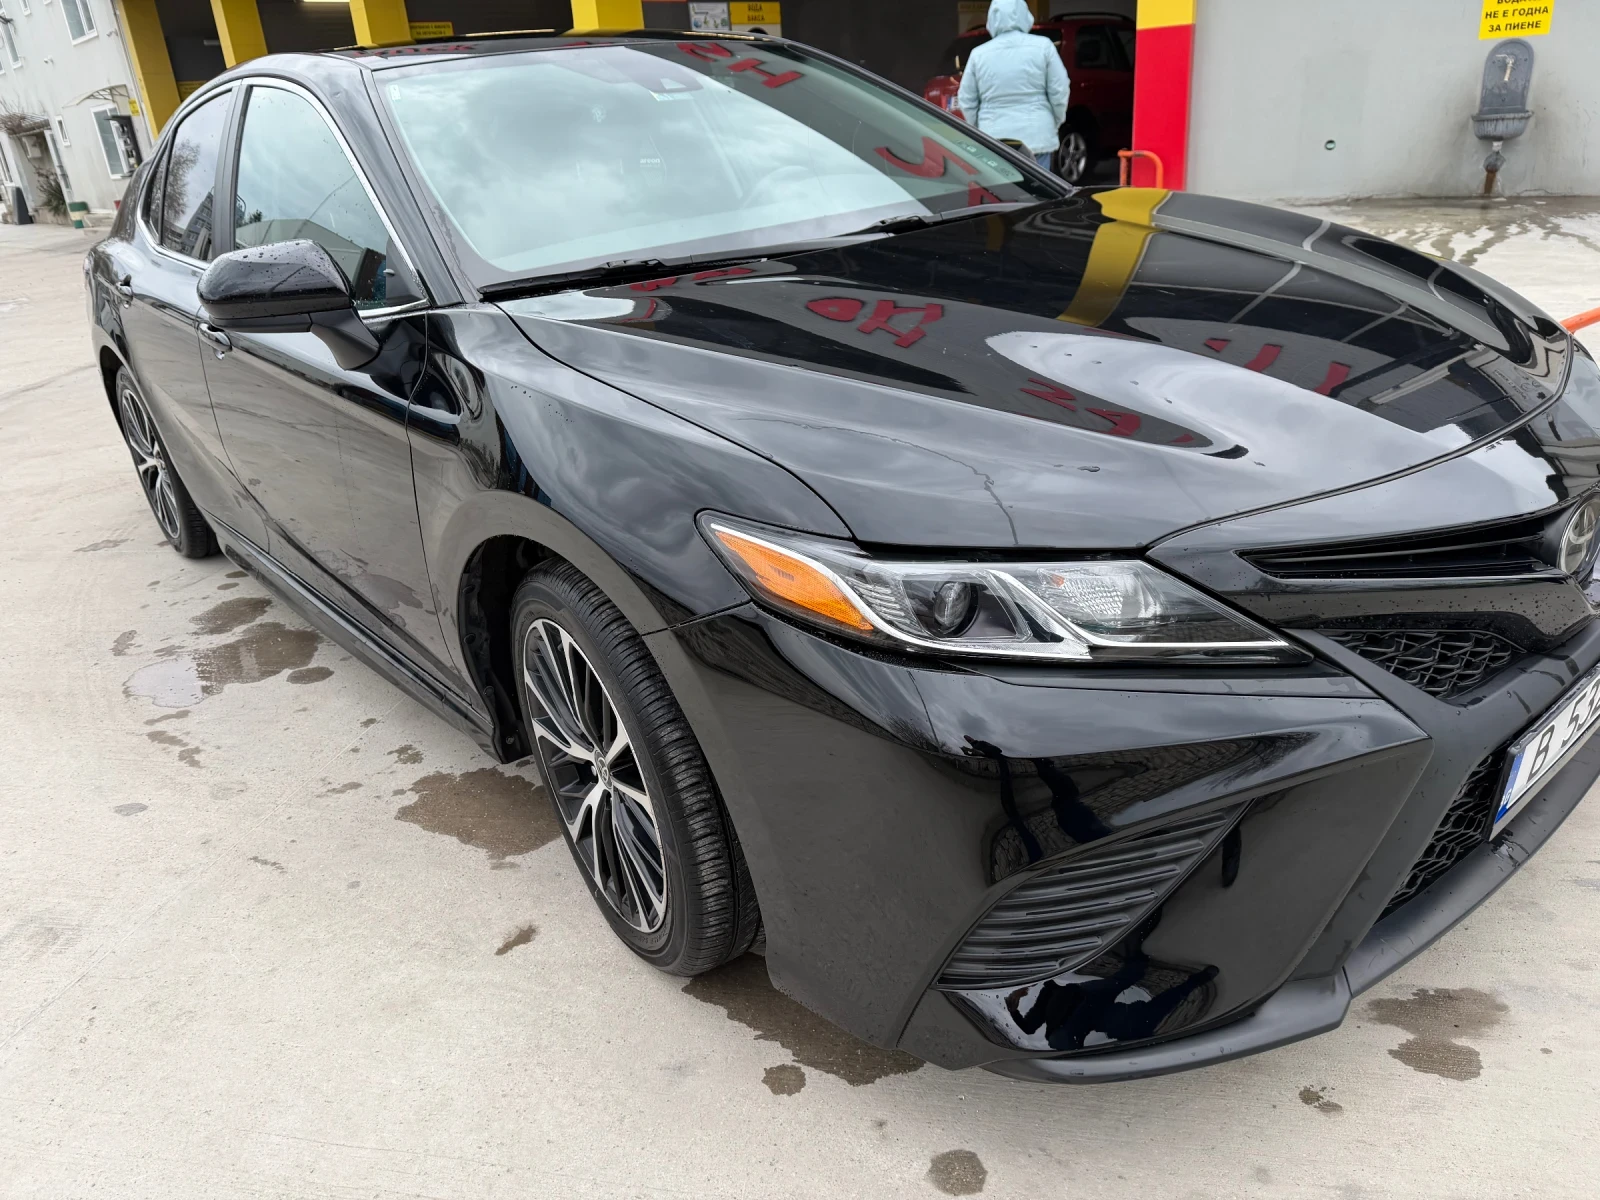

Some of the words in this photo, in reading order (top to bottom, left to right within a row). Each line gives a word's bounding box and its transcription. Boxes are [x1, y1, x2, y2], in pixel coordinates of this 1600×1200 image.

[1485, 11, 1499, 19] НЕ
[1502, 9, 1509, 18] Е
[1512, 6, 1549, 17] ГОДНА
[1488, 24, 1501, 33] ЗА
[1504, 20, 1542, 31] ПИЕНЕ
[1526, 723, 1556, 785] B
